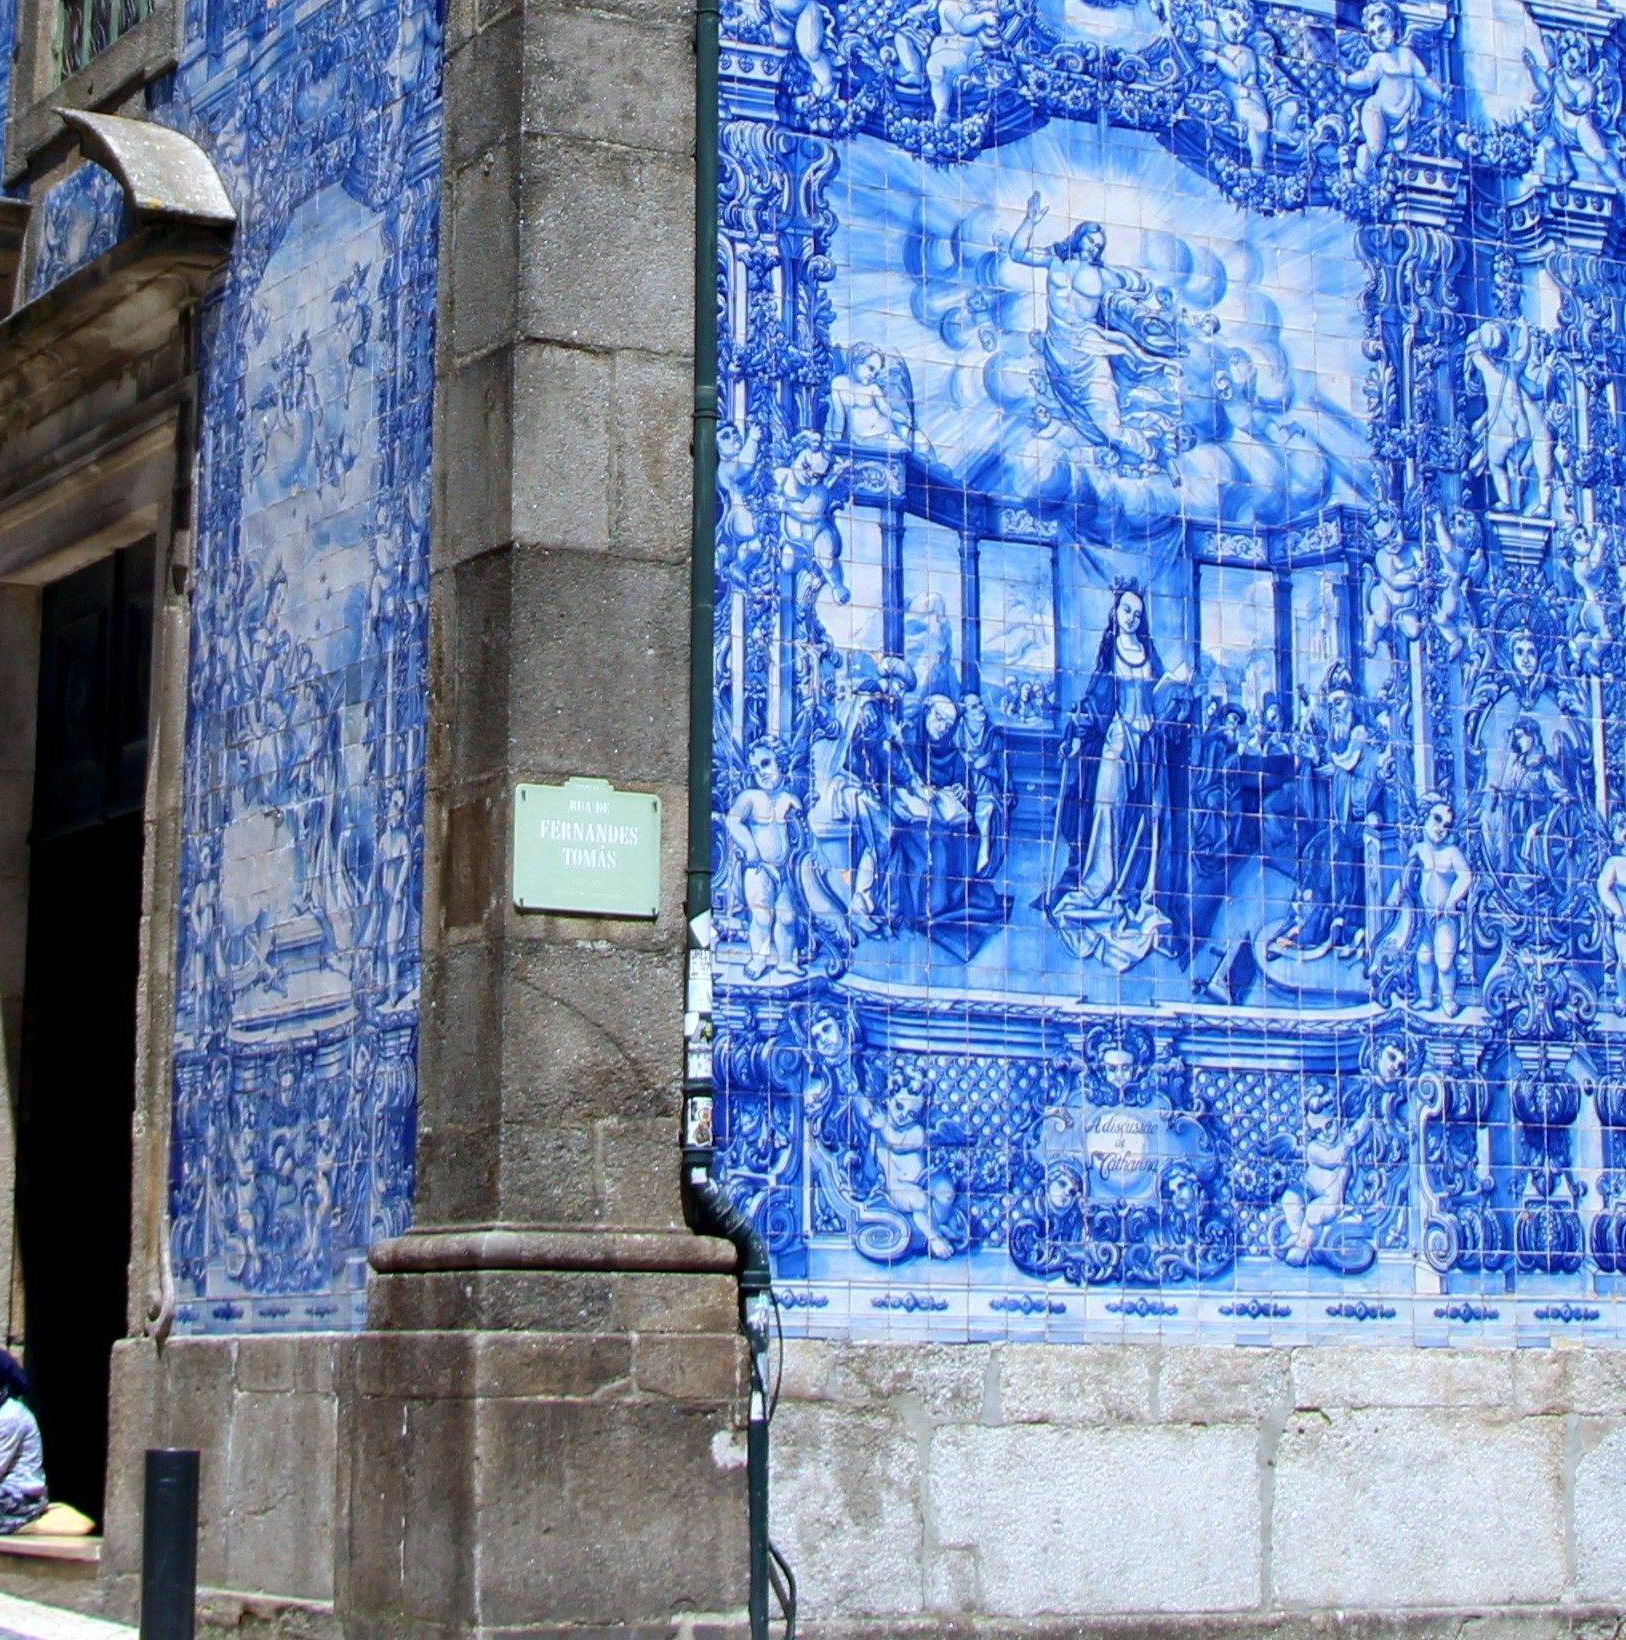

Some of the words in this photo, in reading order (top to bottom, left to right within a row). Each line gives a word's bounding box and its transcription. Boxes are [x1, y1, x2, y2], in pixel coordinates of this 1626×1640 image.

[569, 799, 592, 812] RUA
[594, 801, 612, 815] DE
[540, 818, 640, 846] FERNANDES
[562, 844, 618, 869] TOMÁS
